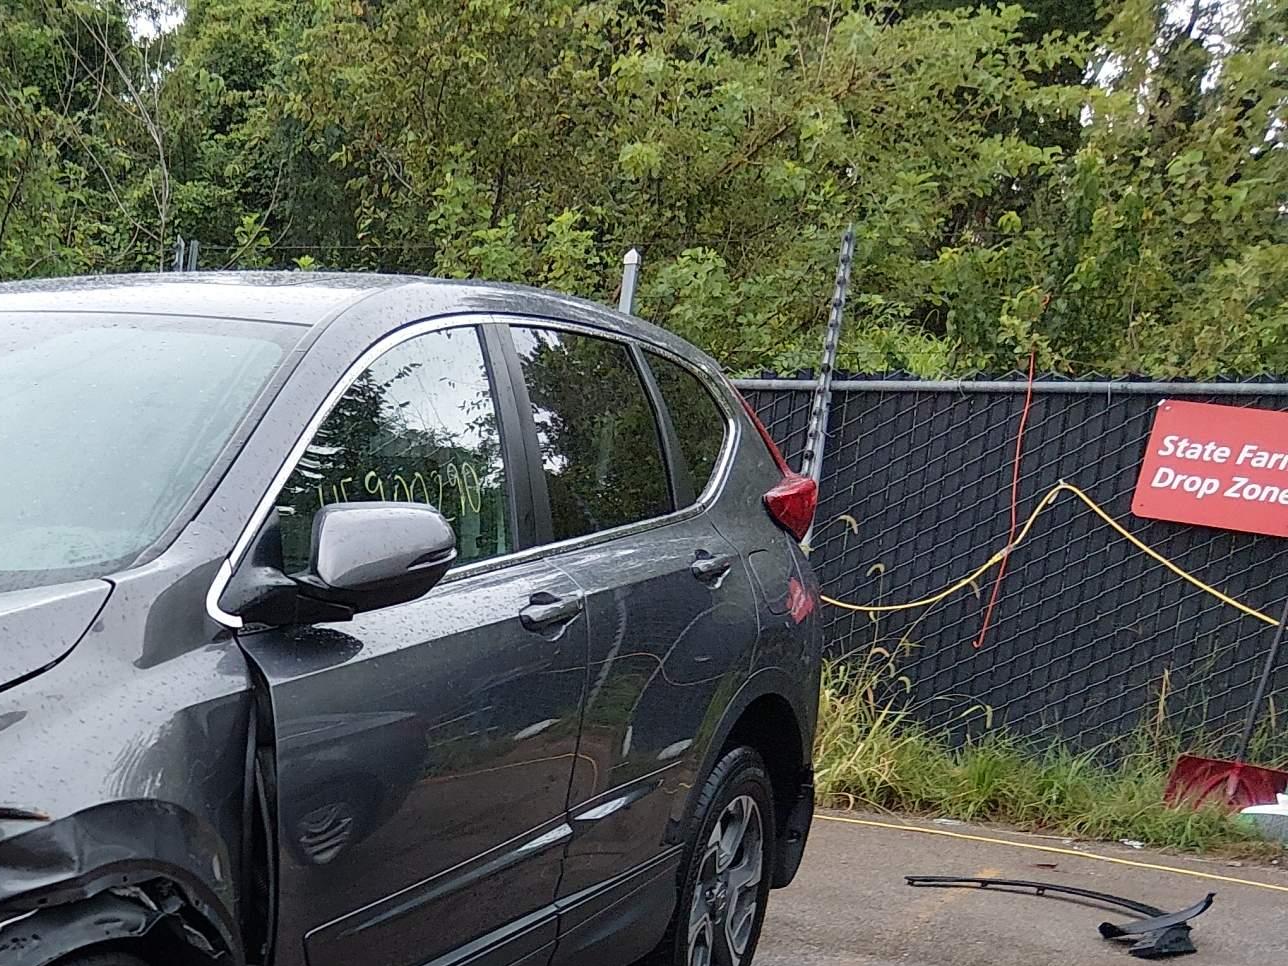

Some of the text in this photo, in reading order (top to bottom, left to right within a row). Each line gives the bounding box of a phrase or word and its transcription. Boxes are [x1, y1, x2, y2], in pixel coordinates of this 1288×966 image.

[1157, 435, 1288, 471] State Far
[1151, 466, 1288, 505] Drop Zone
